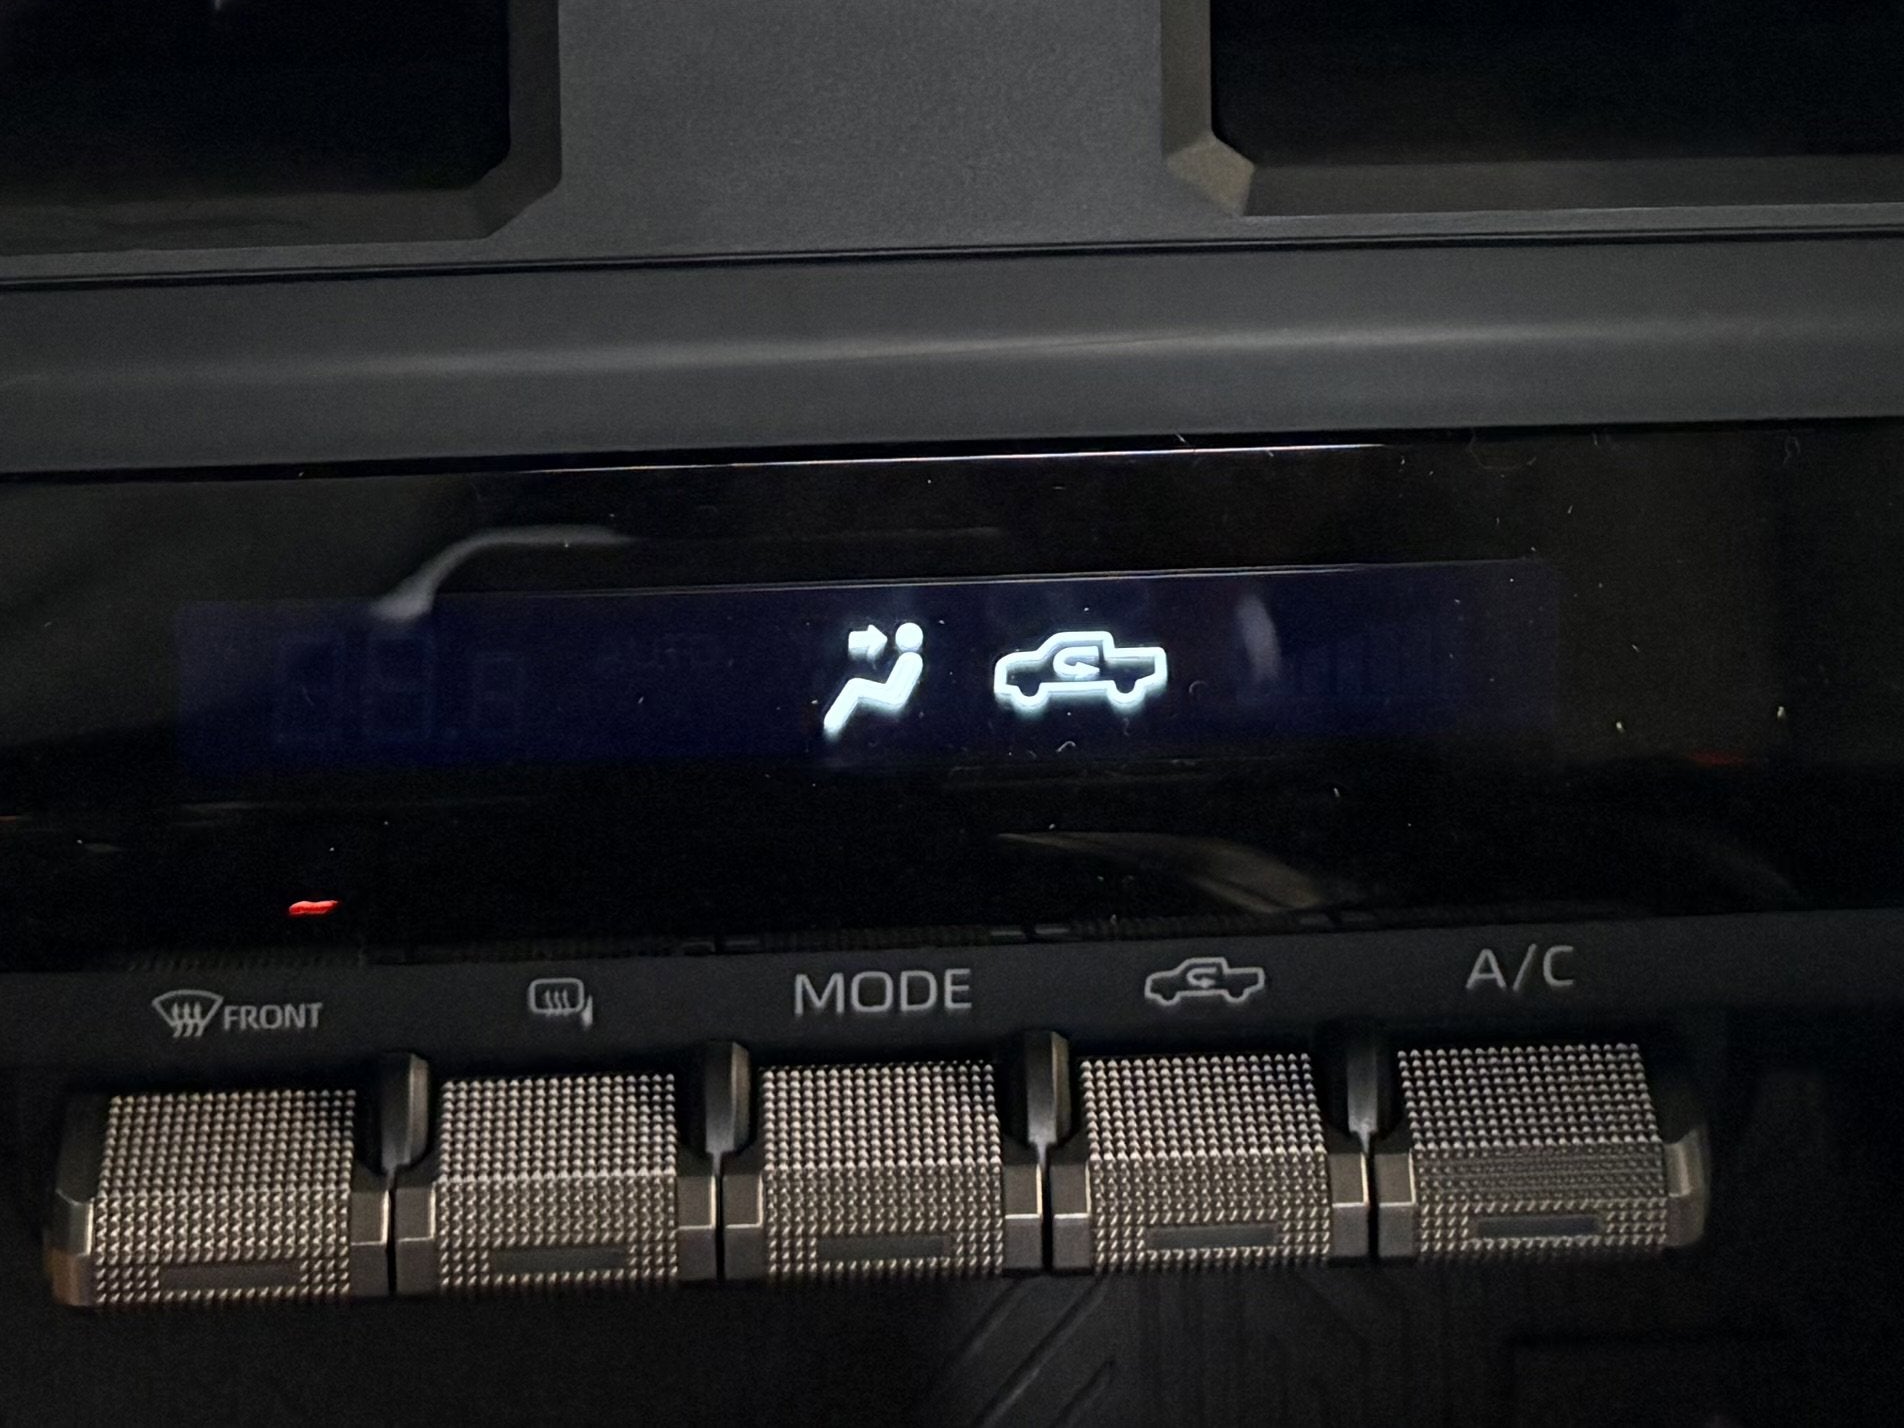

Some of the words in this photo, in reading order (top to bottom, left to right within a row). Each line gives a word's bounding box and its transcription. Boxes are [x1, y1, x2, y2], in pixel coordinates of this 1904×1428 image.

[793, 966, 974, 1016] MODE
[1467, 945, 1577, 993] A/C
[223, 1001, 323, 1032] FRONT
